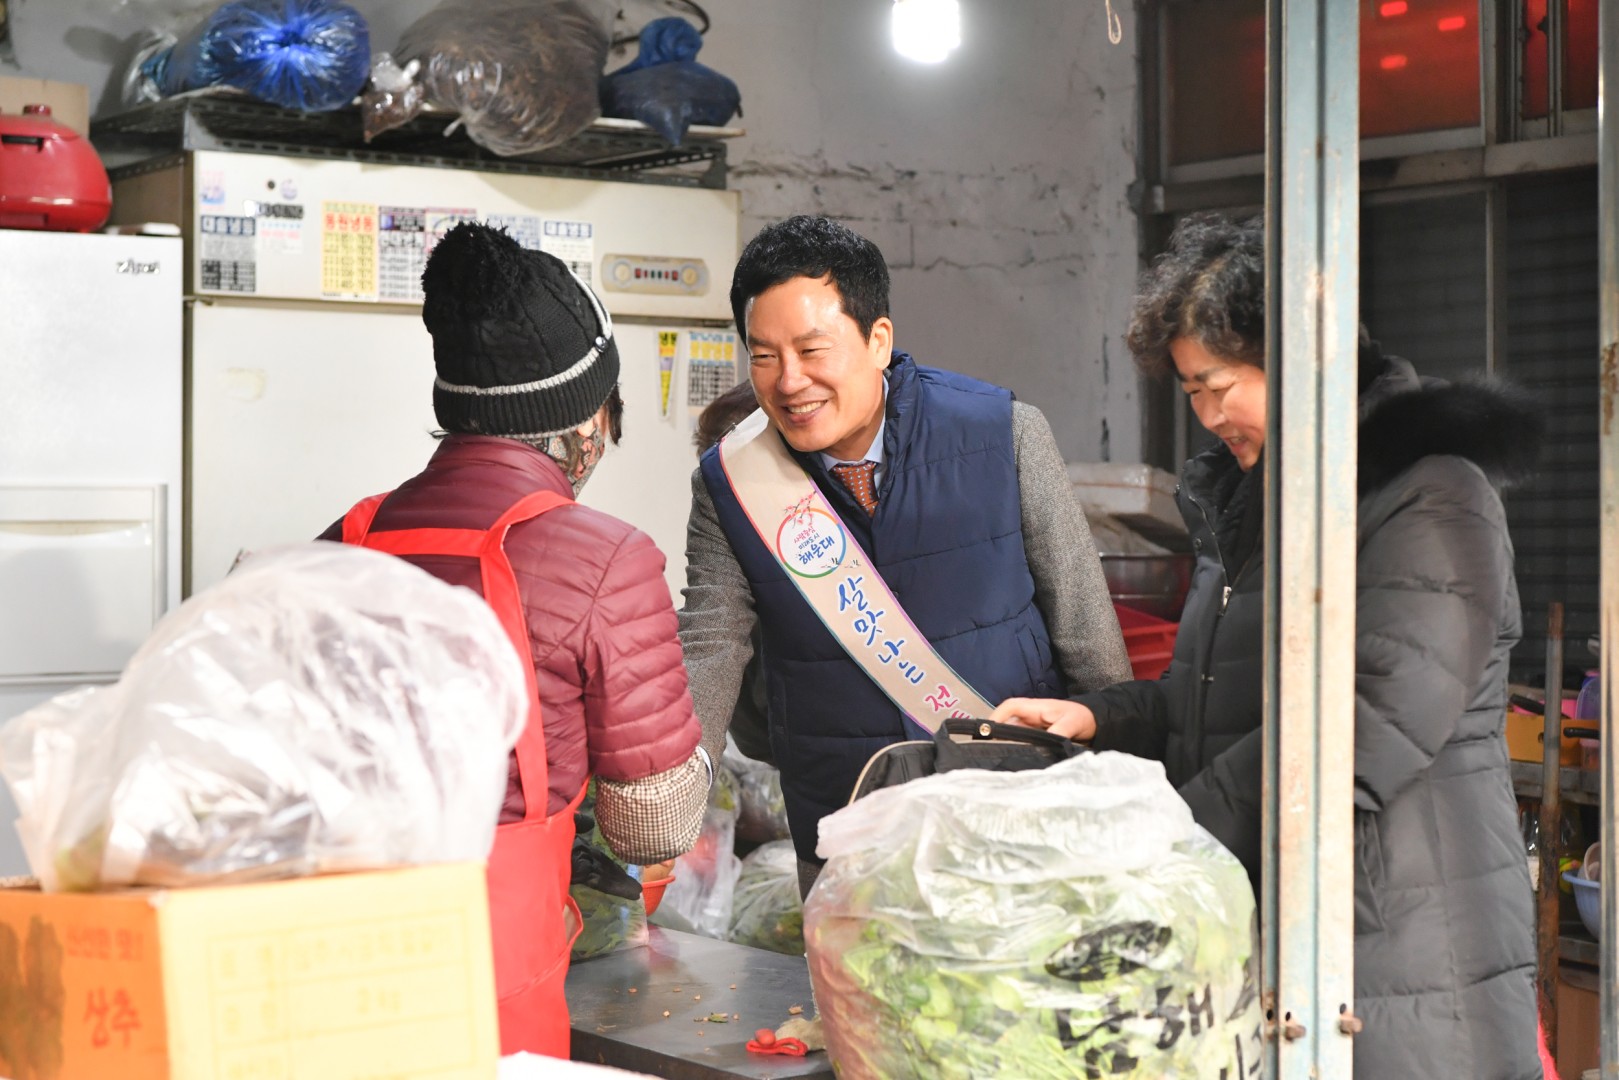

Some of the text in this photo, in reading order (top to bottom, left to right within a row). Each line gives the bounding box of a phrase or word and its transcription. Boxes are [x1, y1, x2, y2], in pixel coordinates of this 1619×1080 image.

[794, 526, 816, 544] 사람중심
[798, 533, 820, 550] 미래도시
[799, 536, 835, 565] 해운대
[83, 986, 142, 1049] 상추
